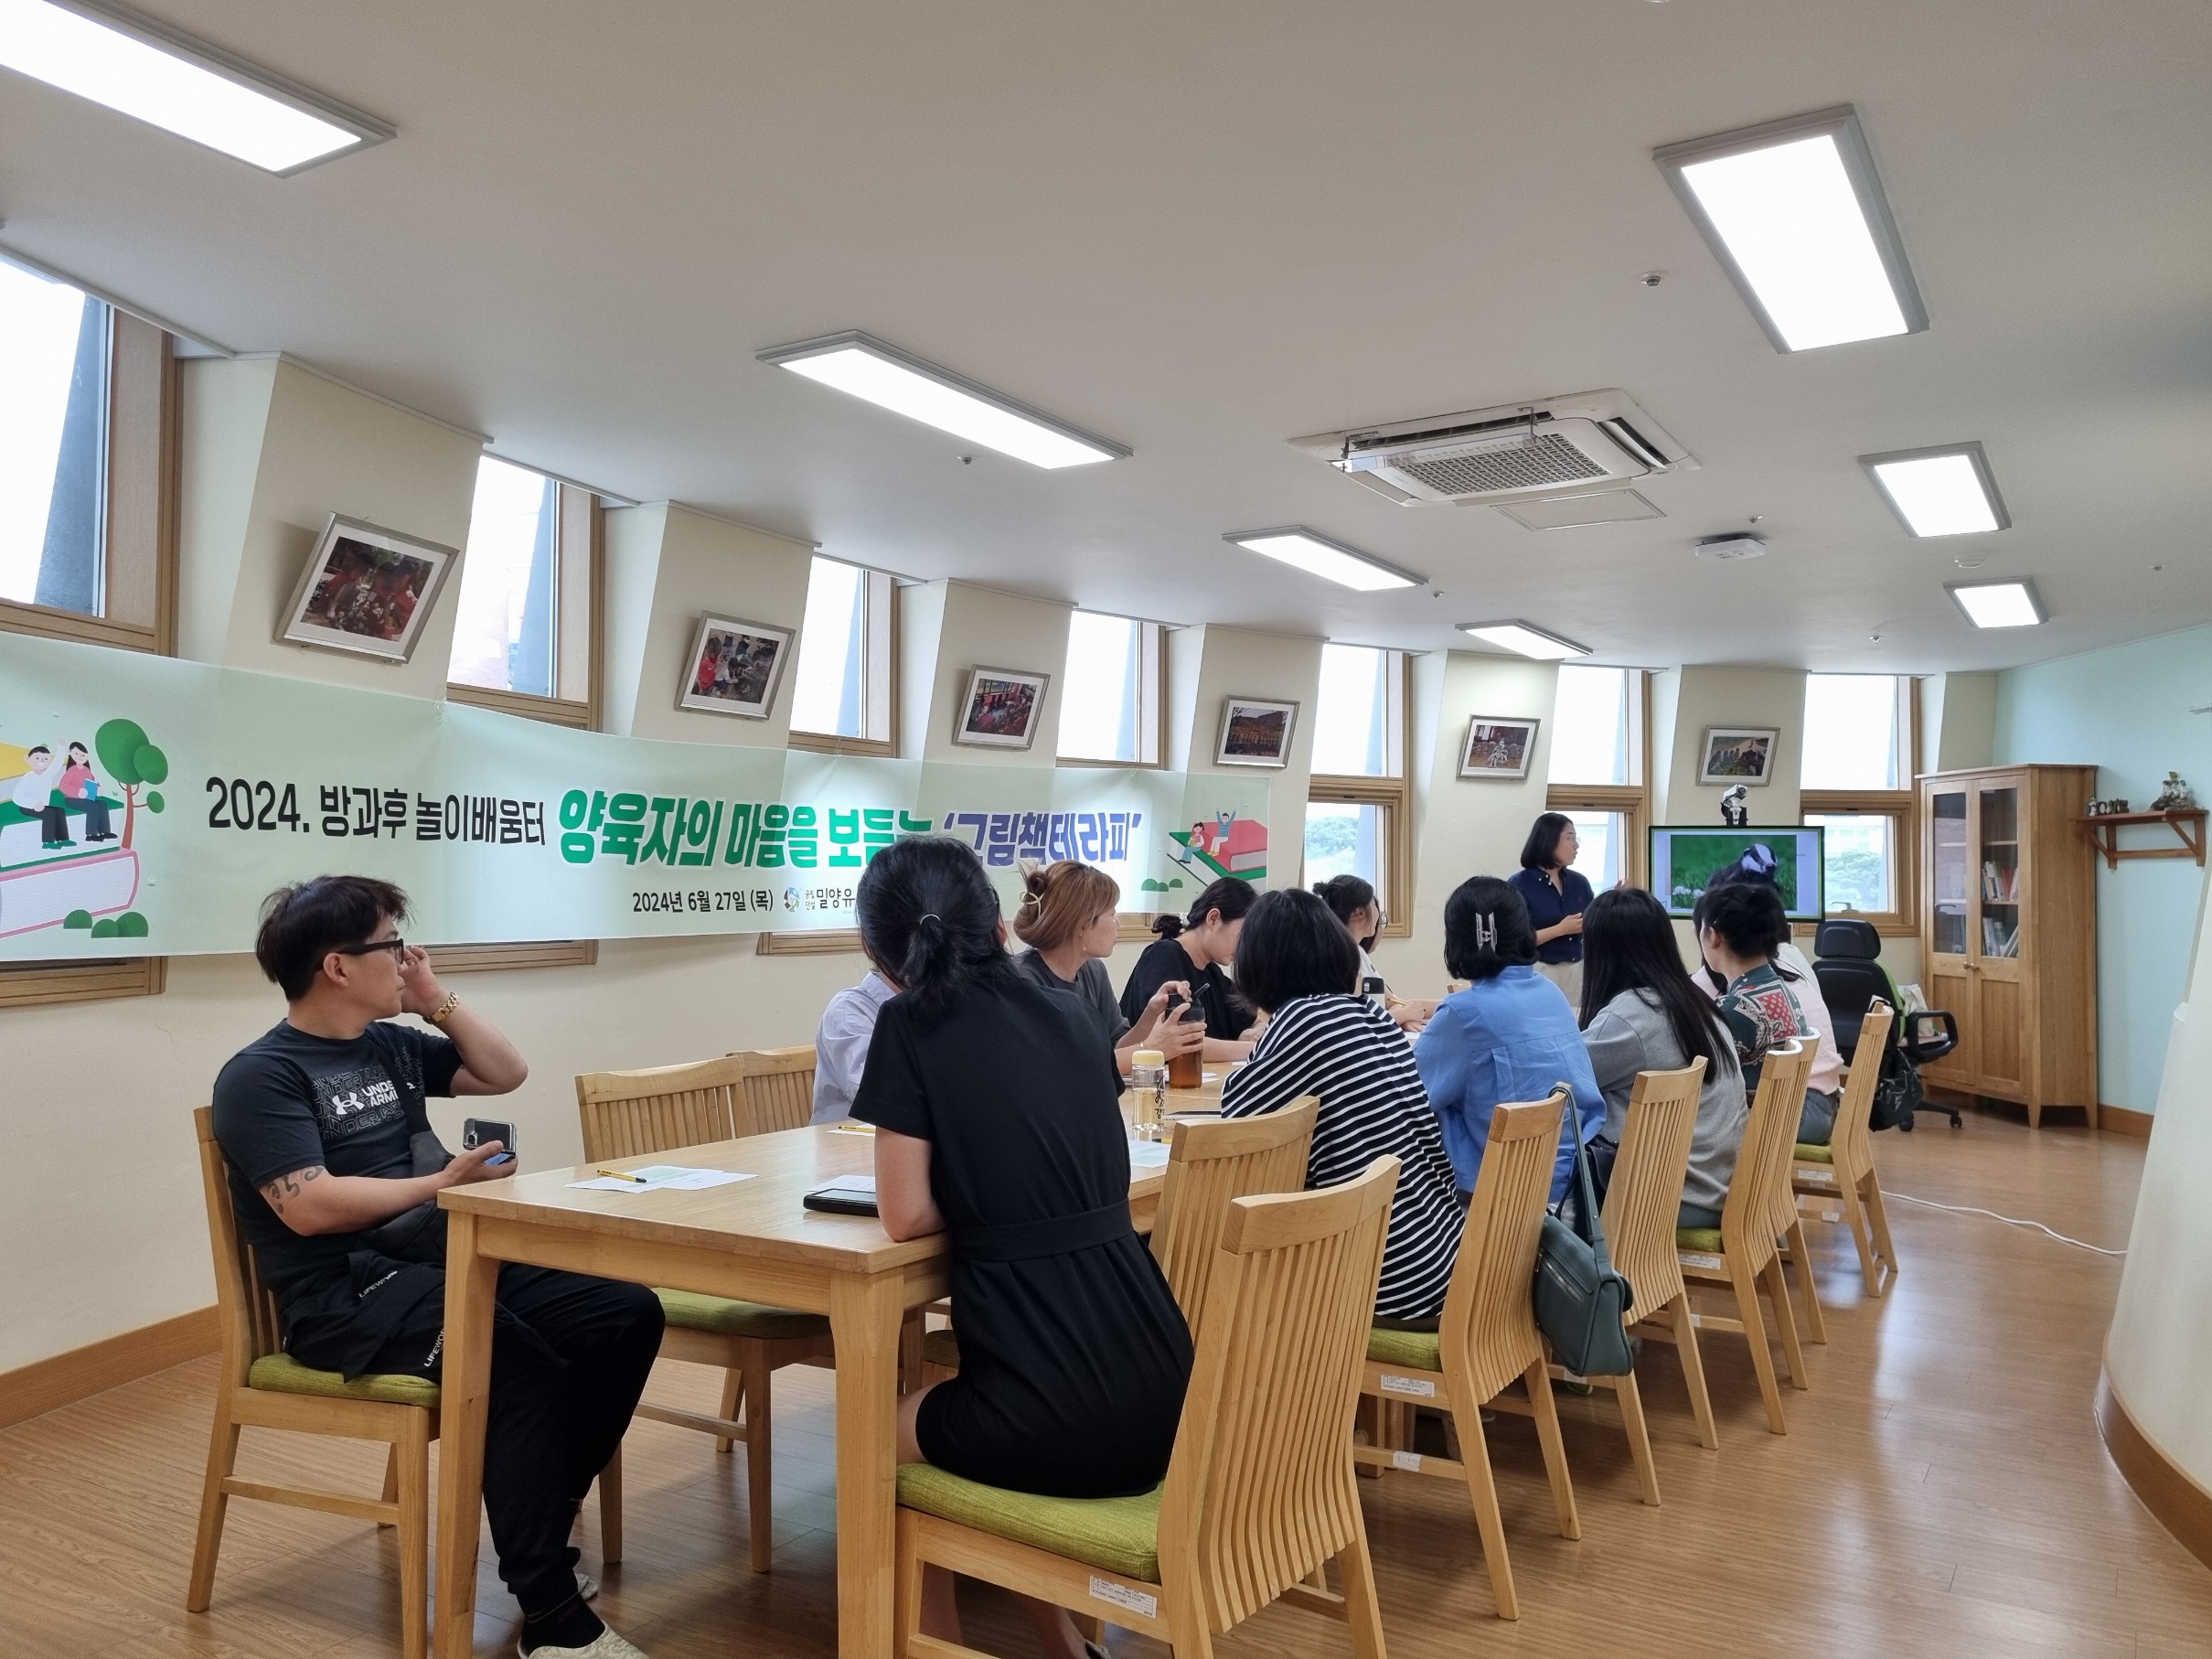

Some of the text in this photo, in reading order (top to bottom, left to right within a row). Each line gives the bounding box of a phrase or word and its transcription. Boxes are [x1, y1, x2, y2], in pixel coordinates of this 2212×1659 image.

[206, 776, 310, 832] 2024.
[320, 785, 408, 839] 방과후
[415, 793, 546, 845] 놀이배움터
[559, 789, 724, 866] 양육자의
[724, 803, 817, 868] 마음을
[633, 889, 774, 913] 2024년 6월 27일 (목)
[817, 887, 856, 908] 밀양유
[361, 1080, 395, 1097] UNDE
